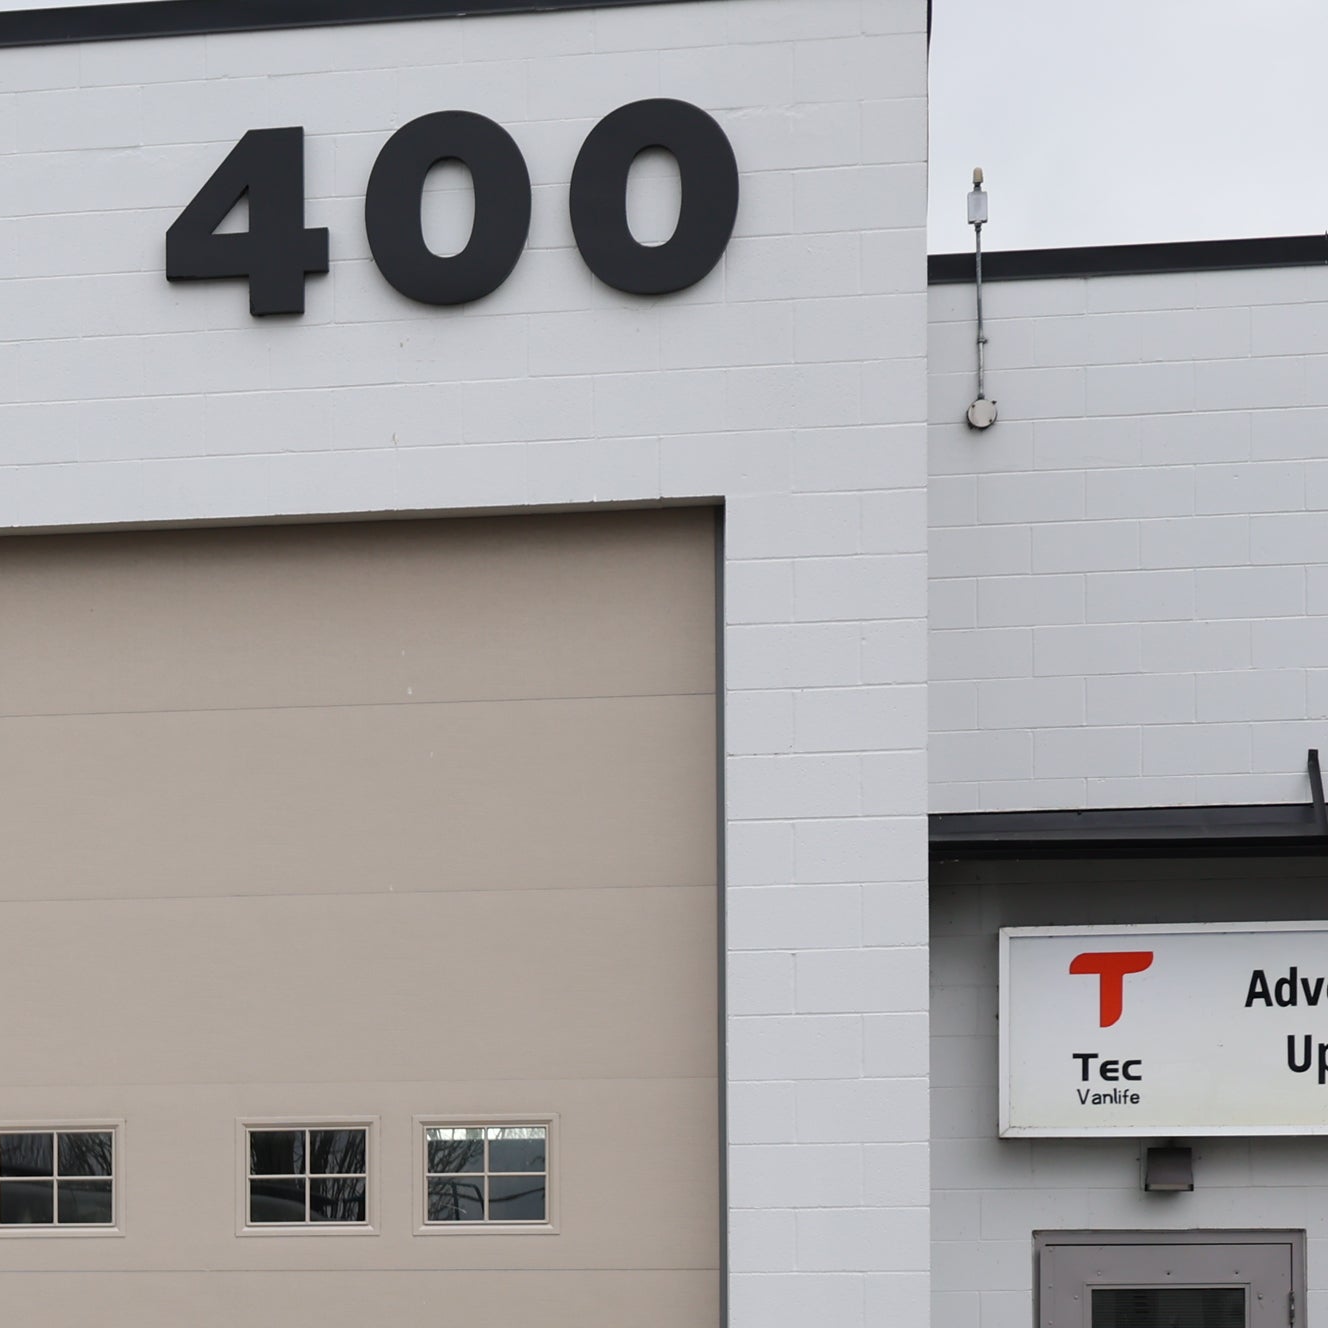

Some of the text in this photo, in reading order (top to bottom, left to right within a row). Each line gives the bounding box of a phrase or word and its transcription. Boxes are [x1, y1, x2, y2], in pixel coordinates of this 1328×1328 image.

[165, 97, 740, 318] 400
[1244, 966, 1328, 1008] Adv
[1077, 1088, 1141, 1105] Vanlife
